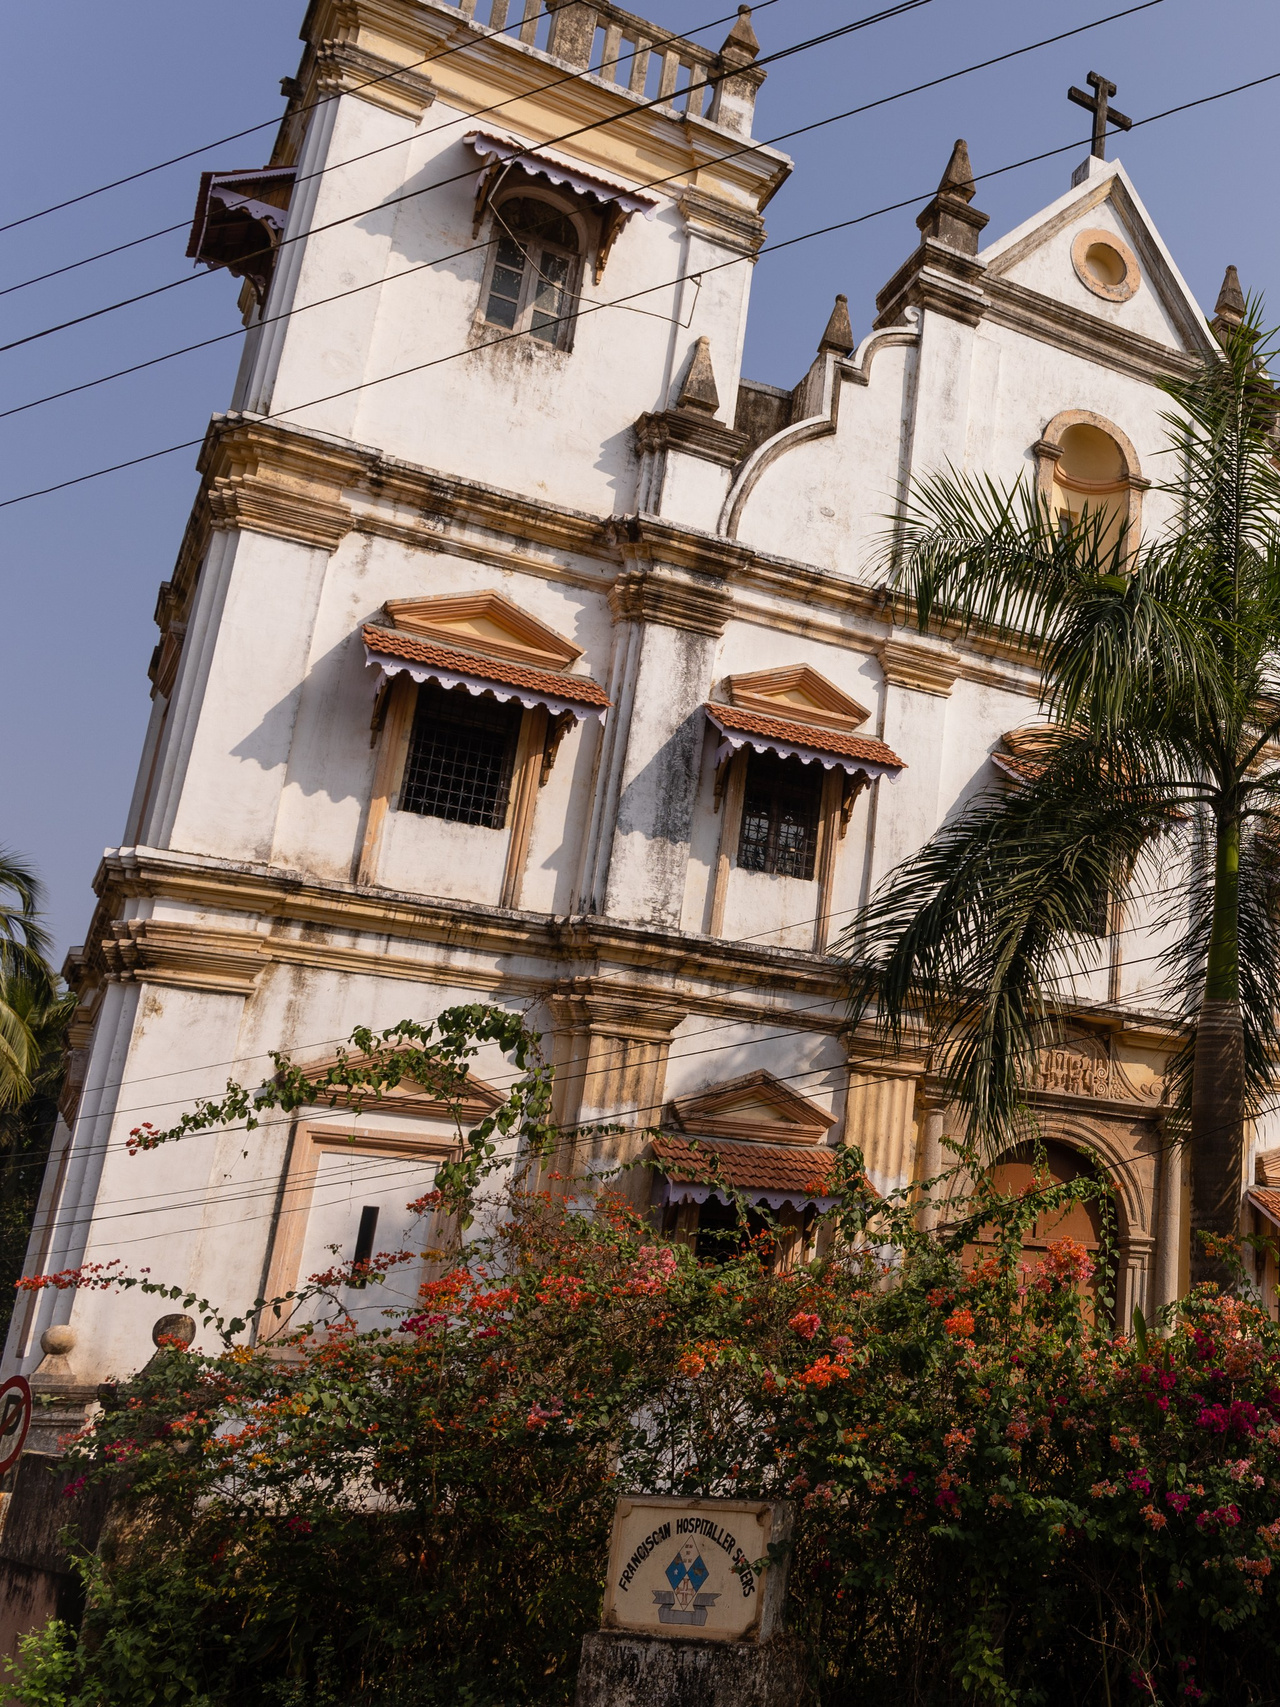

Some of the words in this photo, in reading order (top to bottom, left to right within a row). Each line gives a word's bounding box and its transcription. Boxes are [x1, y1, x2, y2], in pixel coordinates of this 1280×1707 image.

[618, 1521, 671, 1592] FRANCISCAN
[676, 1517, 736, 1555] HOSPITALLER
[732, 1547, 755, 1598] SIERS
